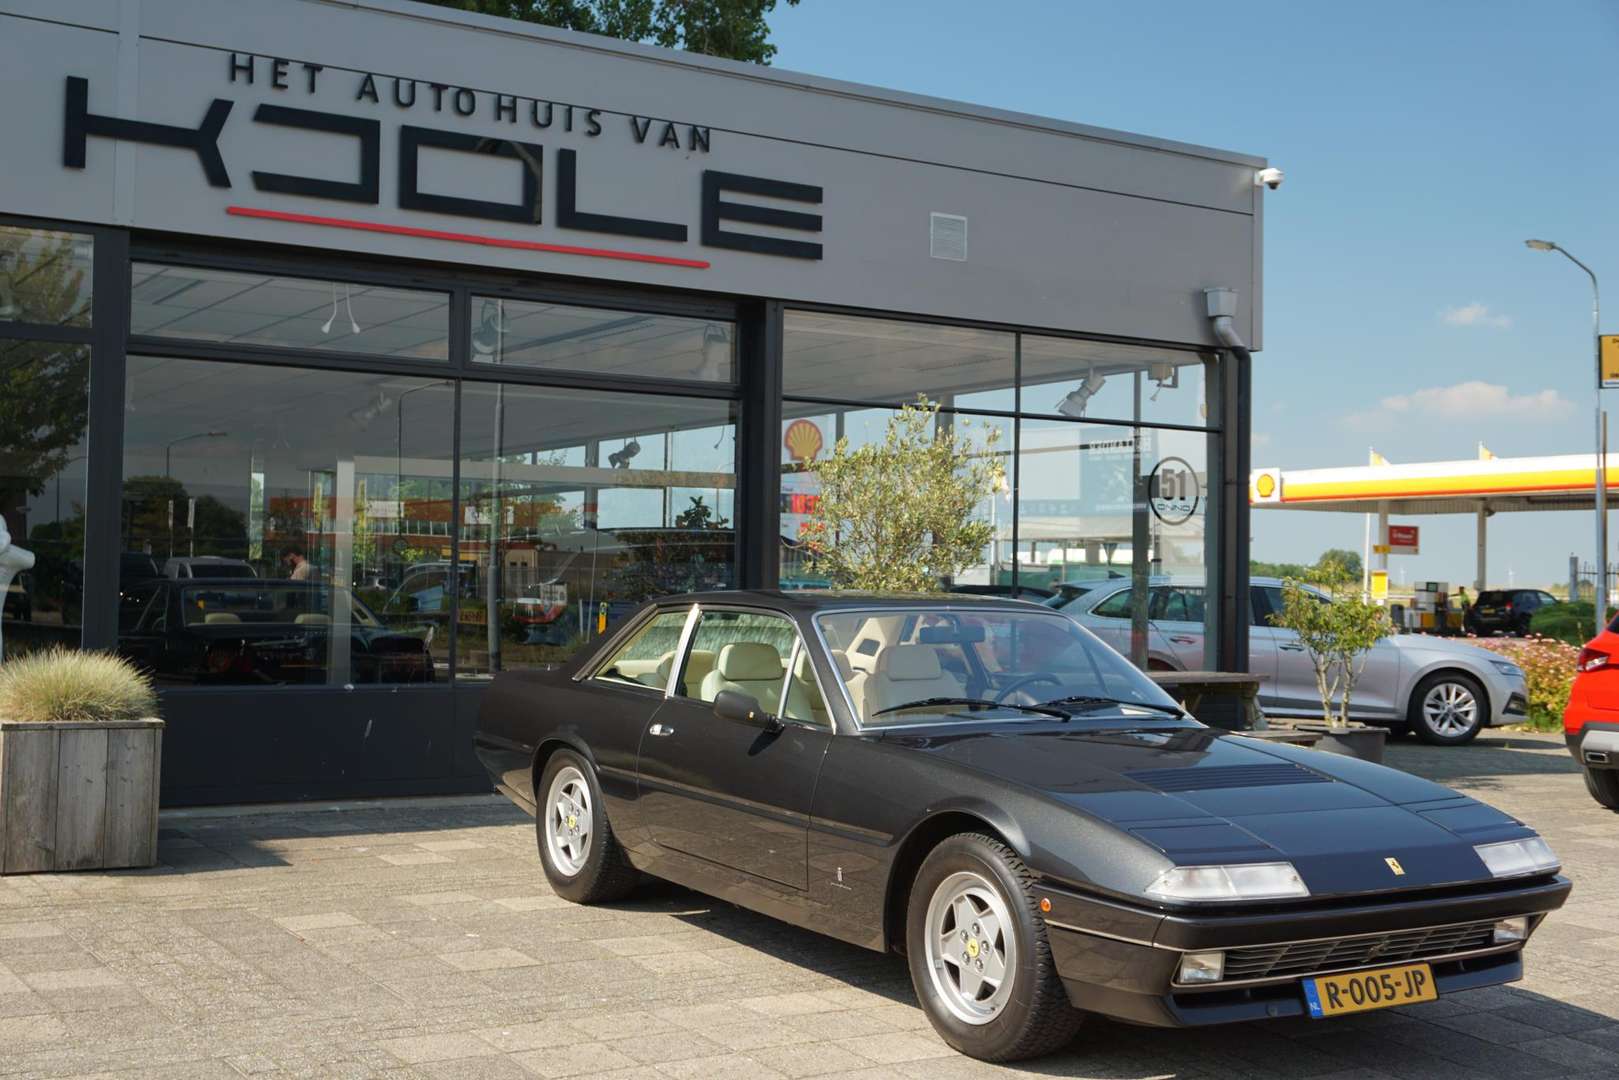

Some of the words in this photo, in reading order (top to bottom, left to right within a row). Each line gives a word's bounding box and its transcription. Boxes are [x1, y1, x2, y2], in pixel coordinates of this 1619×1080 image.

[230, 52, 324, 97] HET
[632, 116, 712, 153] VAN
[63, 75, 824, 261] KOOLE
[1161, 468, 1186, 500] 51
[1325, 970, 1426, 1009] R-005-JP
